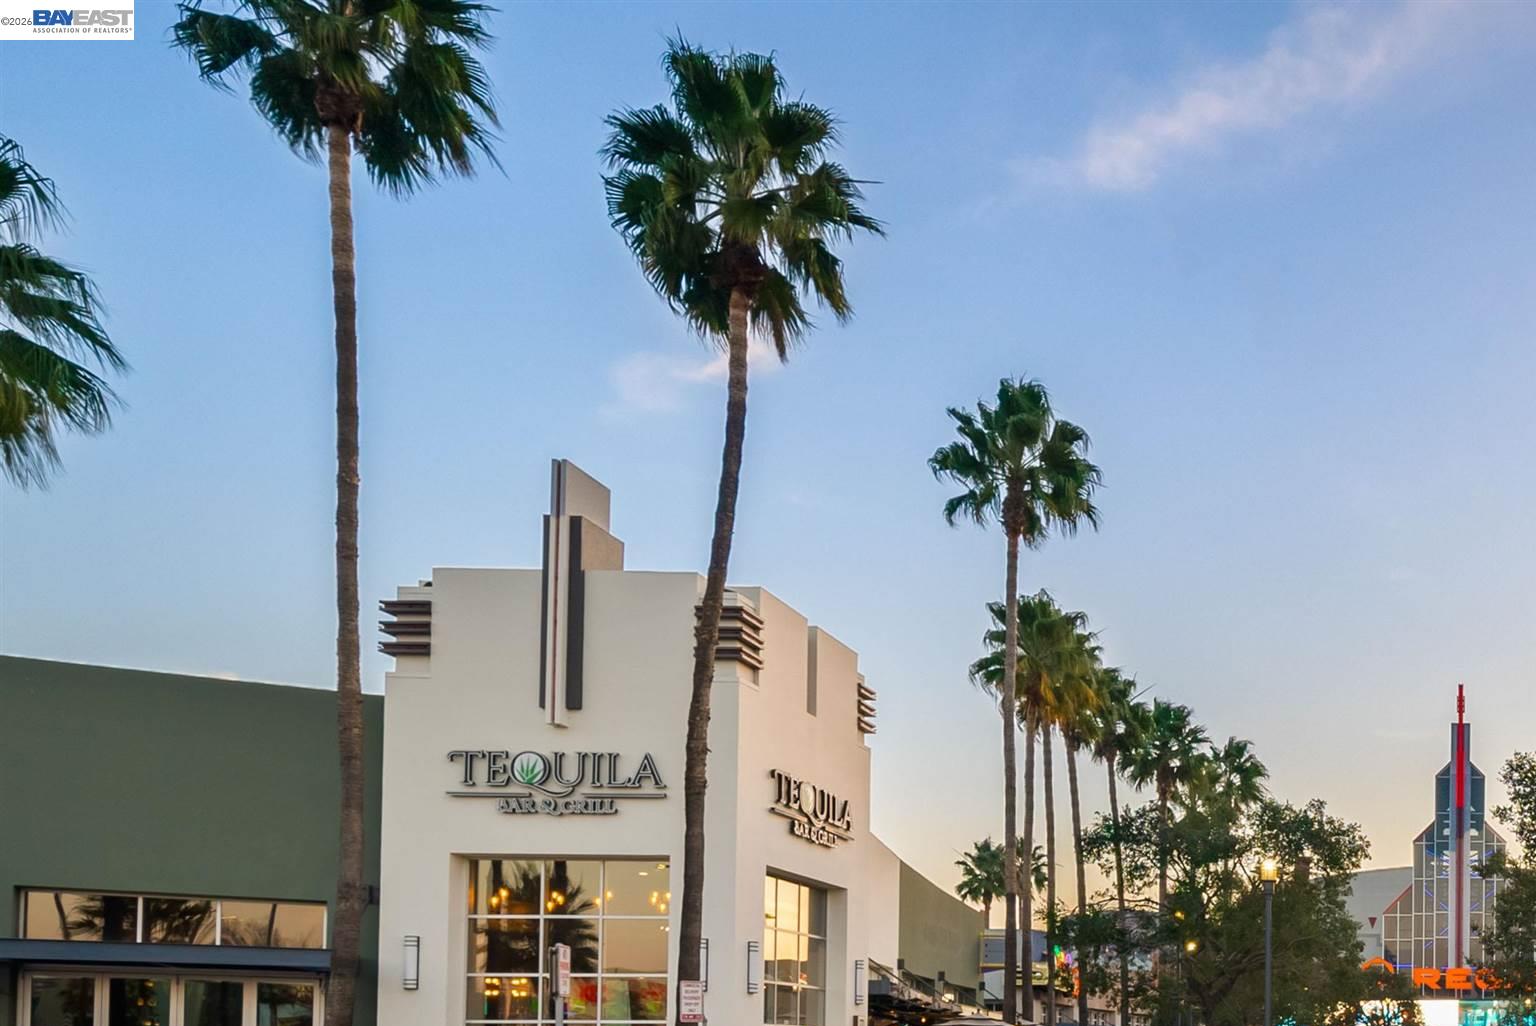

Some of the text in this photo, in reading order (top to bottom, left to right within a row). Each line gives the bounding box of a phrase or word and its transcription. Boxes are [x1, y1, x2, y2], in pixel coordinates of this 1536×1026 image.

[447, 751, 667, 797] TEQUILA
[497, 798, 618, 816] BAR & GRILL
[769, 768, 852, 832] TEQUILA
